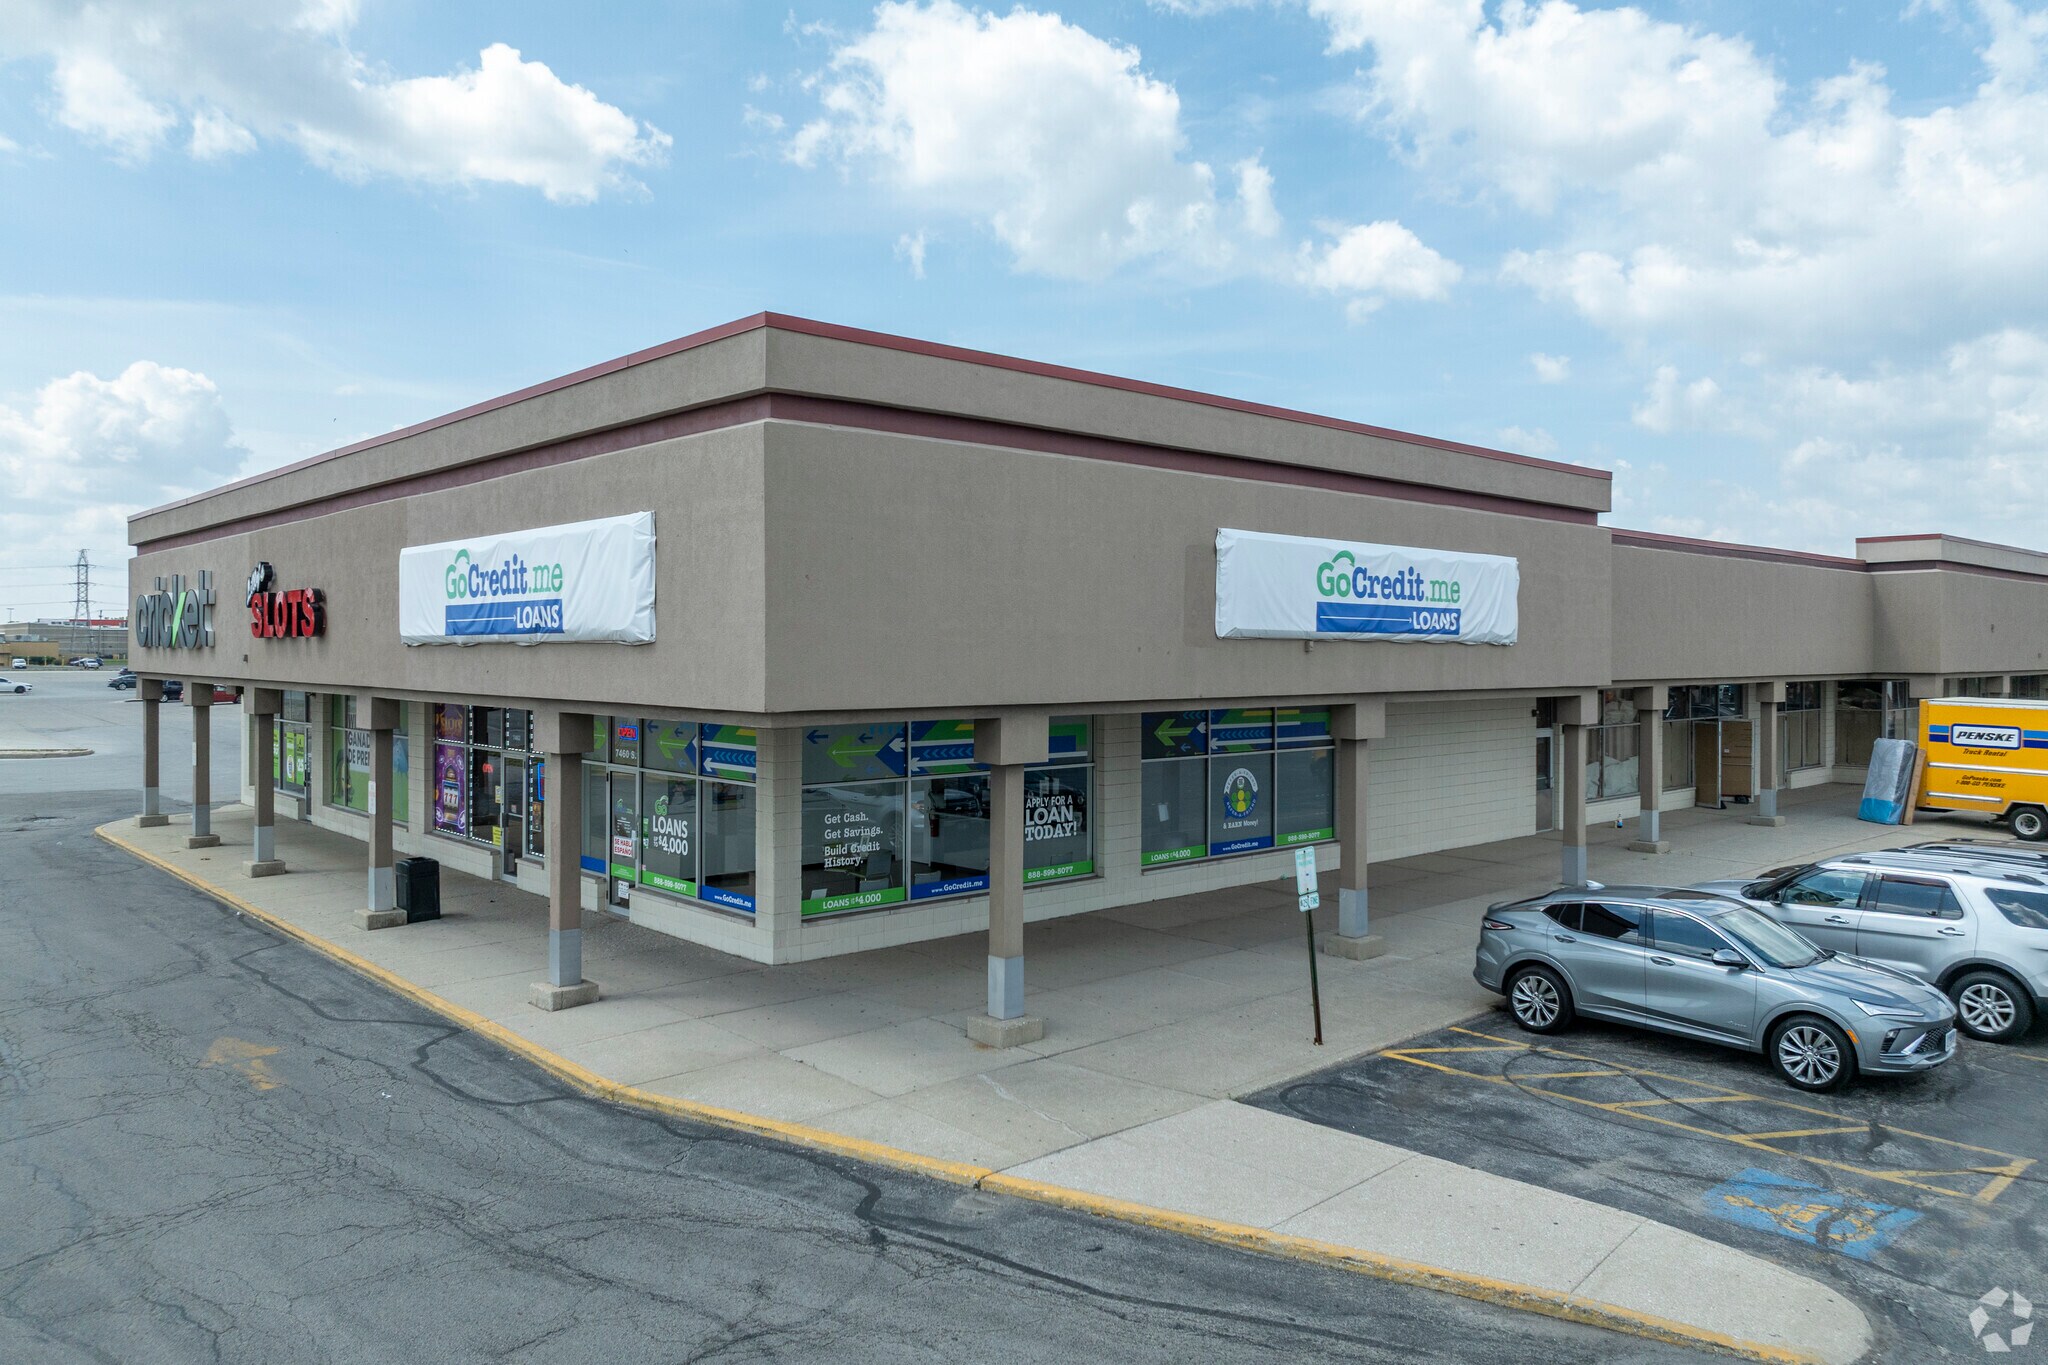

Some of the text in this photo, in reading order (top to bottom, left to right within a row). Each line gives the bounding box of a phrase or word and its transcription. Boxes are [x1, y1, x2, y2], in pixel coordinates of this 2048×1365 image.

[446, 553, 563, 599] GoCredit.me
[1317, 562, 1461, 604] GoCredit.me
[136, 570, 213, 649] cricket
[251, 587, 320, 639] SLOTS
[516, 605, 560, 629] LOANS
[1412, 611, 1458, 632] LOANS
[618, 727, 636, 738] OPEN
[1956, 731, 2015, 743] PENSKE
[357, 749, 370, 766] PRE
[615, 749, 629, 759] 7460
[1983, 749, 2008, 757] Rental
[655, 799, 668, 816] Go
[1026, 794, 1073, 808] APPLY FOR A
[824, 812, 869, 824] Get Cash.
[1026, 805, 1073, 826] LOAN
[652, 815, 688, 838] LOANS
[824, 826, 883, 839] Get Savings.
[1025, 821, 1077, 841] TODAY!
[824, 841, 880, 856] Build Credit
[824, 857, 863, 868] History.
[1151, 852, 1169, 861] LOANS
[1028, 866, 1073, 879] 888-599-5077
[931, 880, 983, 893] www.GoCredit.me
[823, 898, 849, 909] LOANS
